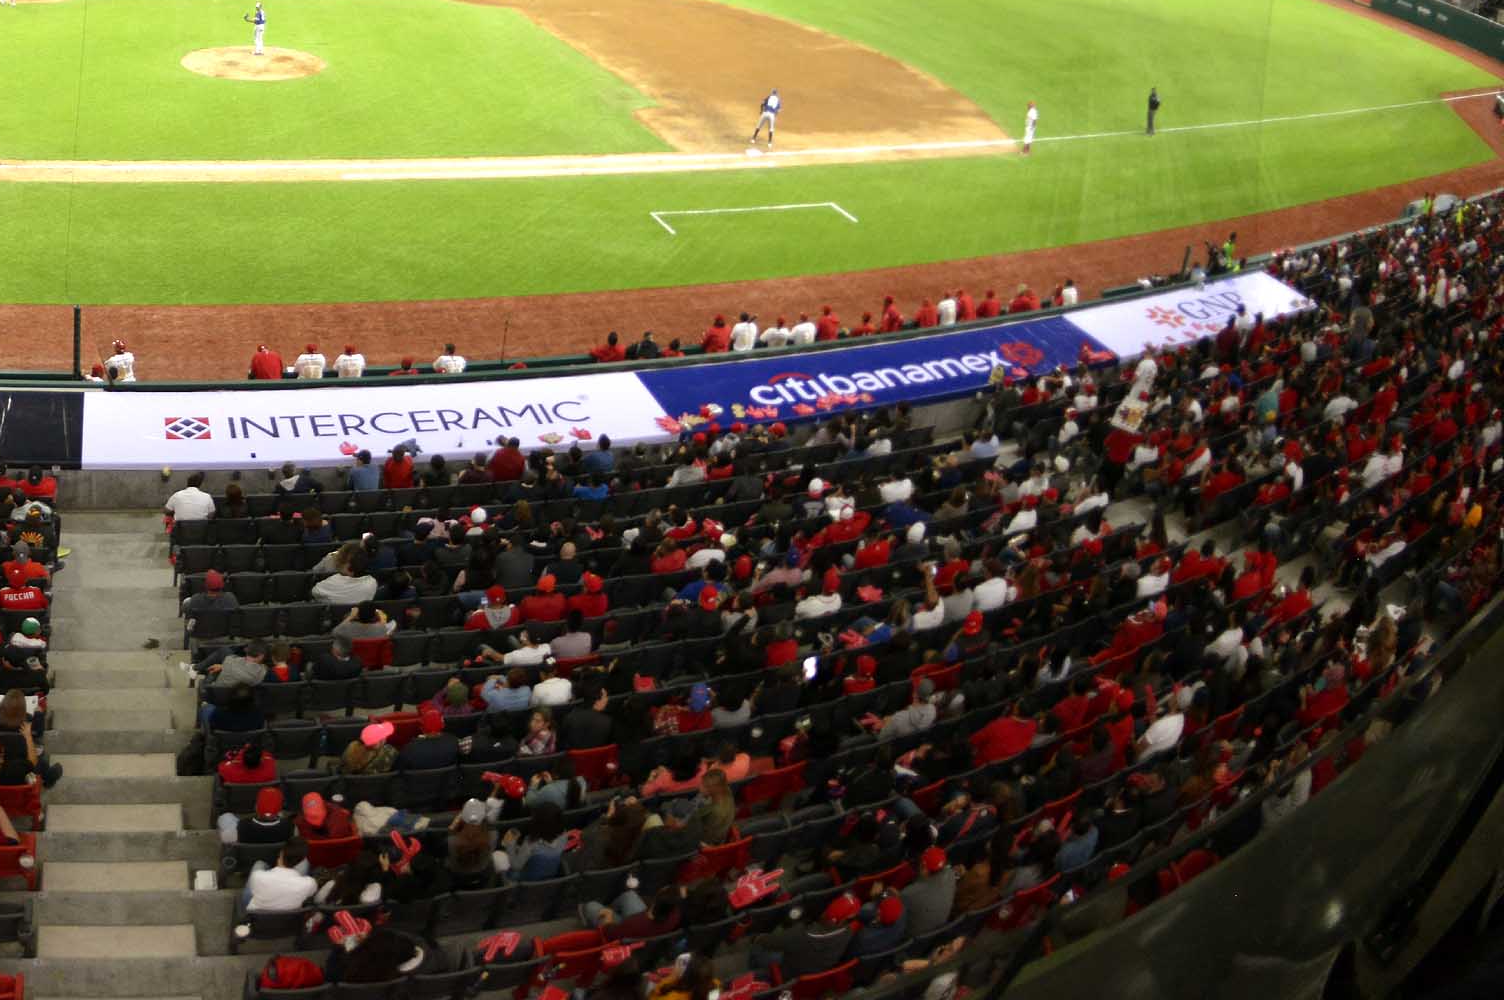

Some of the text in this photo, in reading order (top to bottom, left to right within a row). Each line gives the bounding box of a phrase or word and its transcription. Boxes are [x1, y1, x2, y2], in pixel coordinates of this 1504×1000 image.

[1178, 291, 1242, 320] GNP
[749, 350, 1011, 405] citibanamex
[228, 400, 591, 439] INTERCERAMIC
